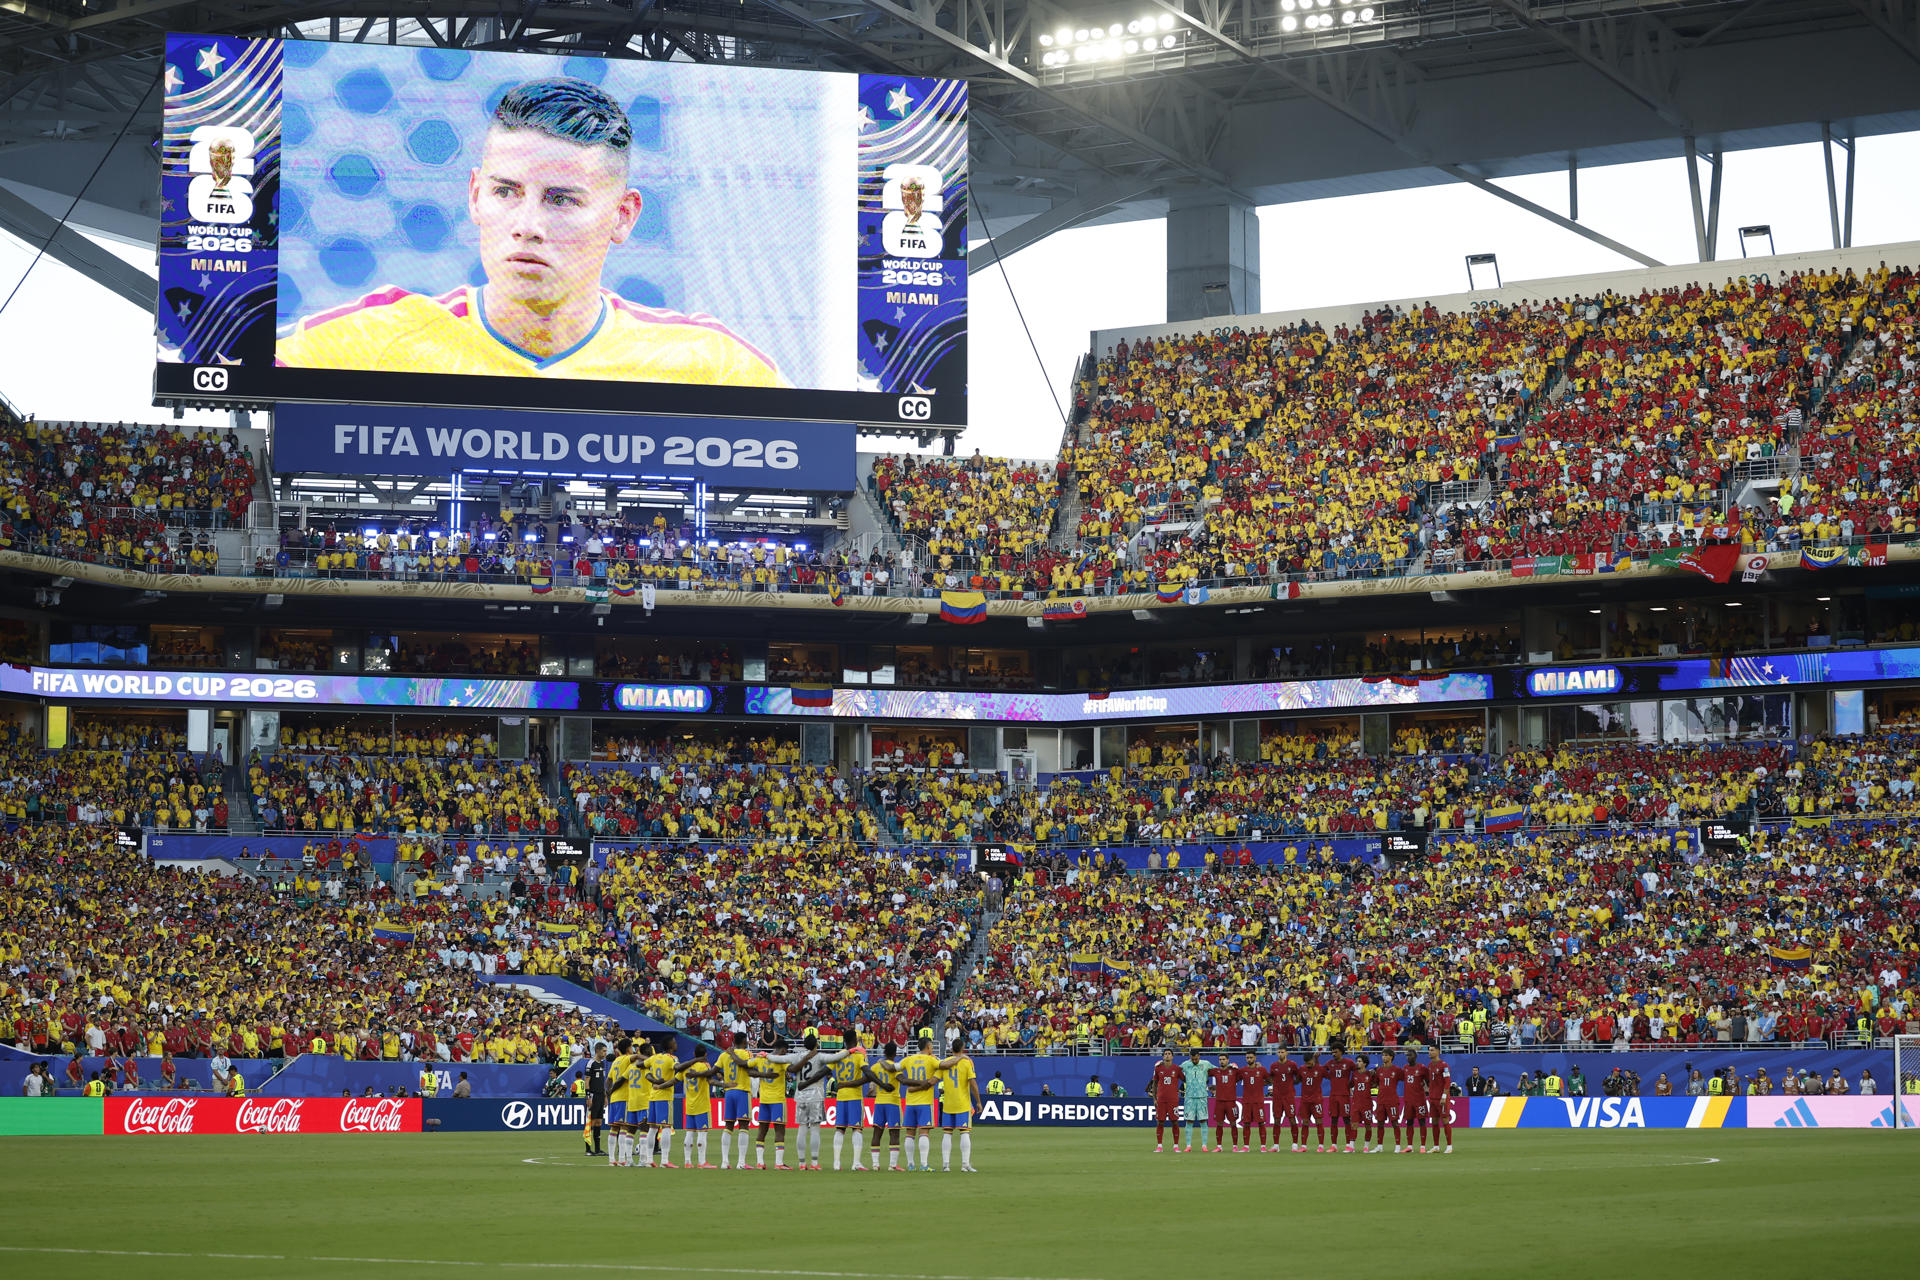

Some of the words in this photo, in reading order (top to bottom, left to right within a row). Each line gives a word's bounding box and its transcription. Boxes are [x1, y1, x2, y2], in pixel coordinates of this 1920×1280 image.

[207, 204, 236, 214] FIFA
[188, 226, 228, 236] WORLD
[230, 227, 252, 237] CUP
[187, 236, 252, 253] 2026
[900, 238, 926, 249] FIFA
[191, 258, 248, 272] MIAMI
[882, 260, 920, 270] WORLD
[922, 262, 943, 271] CUP
[882, 270, 943, 286] 2026
[1738, 273, 1769, 288] 30
[886, 291, 938, 305] MIAMI
[197, 370, 224, 388] CC
[902, 400, 927, 417] CC
[334, 424, 420, 457] FIFA
[425, 427, 570, 462] WORLD
[577, 432, 656, 464] CUP
[662, 436, 799, 470] 2026
[33, 672, 78, 693] FIFA
[82, 674, 172, 696] WORLD
[176, 676, 226, 697] CUP
[230, 678, 316, 699] 2026
[1534, 668, 1615, 692] MIAMI
[622, 688, 704, 708] MIAMI
[1083, 696, 1167, 714] #FIFAWorldCup
[629, 1069, 641, 1088] 22
[729, 1062, 737, 1080] 3
[837, 1062, 855, 1081] 23
[912, 1066, 926, 1080] 10
[949, 1068, 958, 1088] 4
[1358, 1083, 1365, 1091] 23
[1384, 1078, 1390, 1086] 11
[124, 1098, 199, 1133] Coca-Cola
[236, 1098, 304, 1132] Coca-Cola
[340, 1098, 408, 1132] Coca-Cola
[538, 1104, 608, 1125] HYUN
[980, 1100, 1031, 1121] ADI
[1558, 1097, 1645, 1128] VISA
